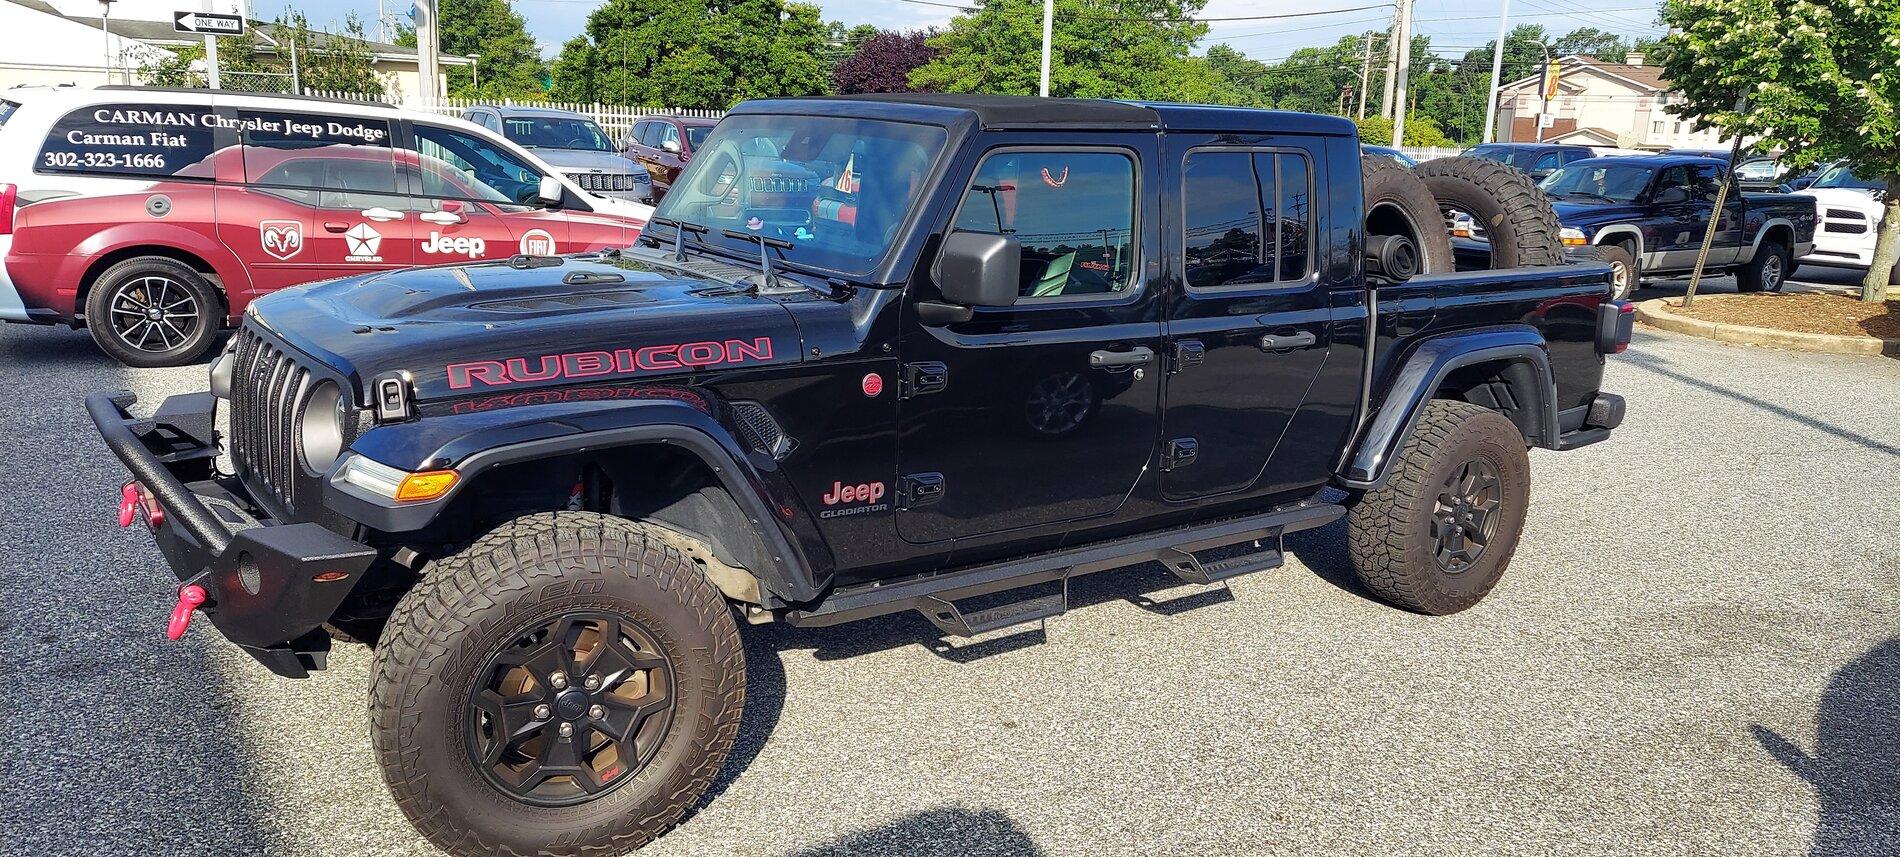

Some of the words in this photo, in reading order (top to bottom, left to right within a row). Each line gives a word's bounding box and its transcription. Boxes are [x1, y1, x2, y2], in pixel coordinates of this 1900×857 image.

[194, 18, 213, 27] ONE
[217, 20, 236, 28] WAY
[94, 109, 196, 127] CARMAN
[200, 113, 281, 132] Chrysler
[283, 119, 323, 138] Jeep
[327, 122, 383, 141] Dodge
[66, 130, 146, 146] Carman
[150, 132, 187, 147] Fiat
[45, 152, 165, 168] 302-323-1666
[421, 231, 485, 258] Jeep
[528, 239, 549, 256] FIAT
[446, 336, 774, 389] RUBICON
[822, 481, 885, 506] Jeep
[820, 503, 888, 519] GLADIATOR
